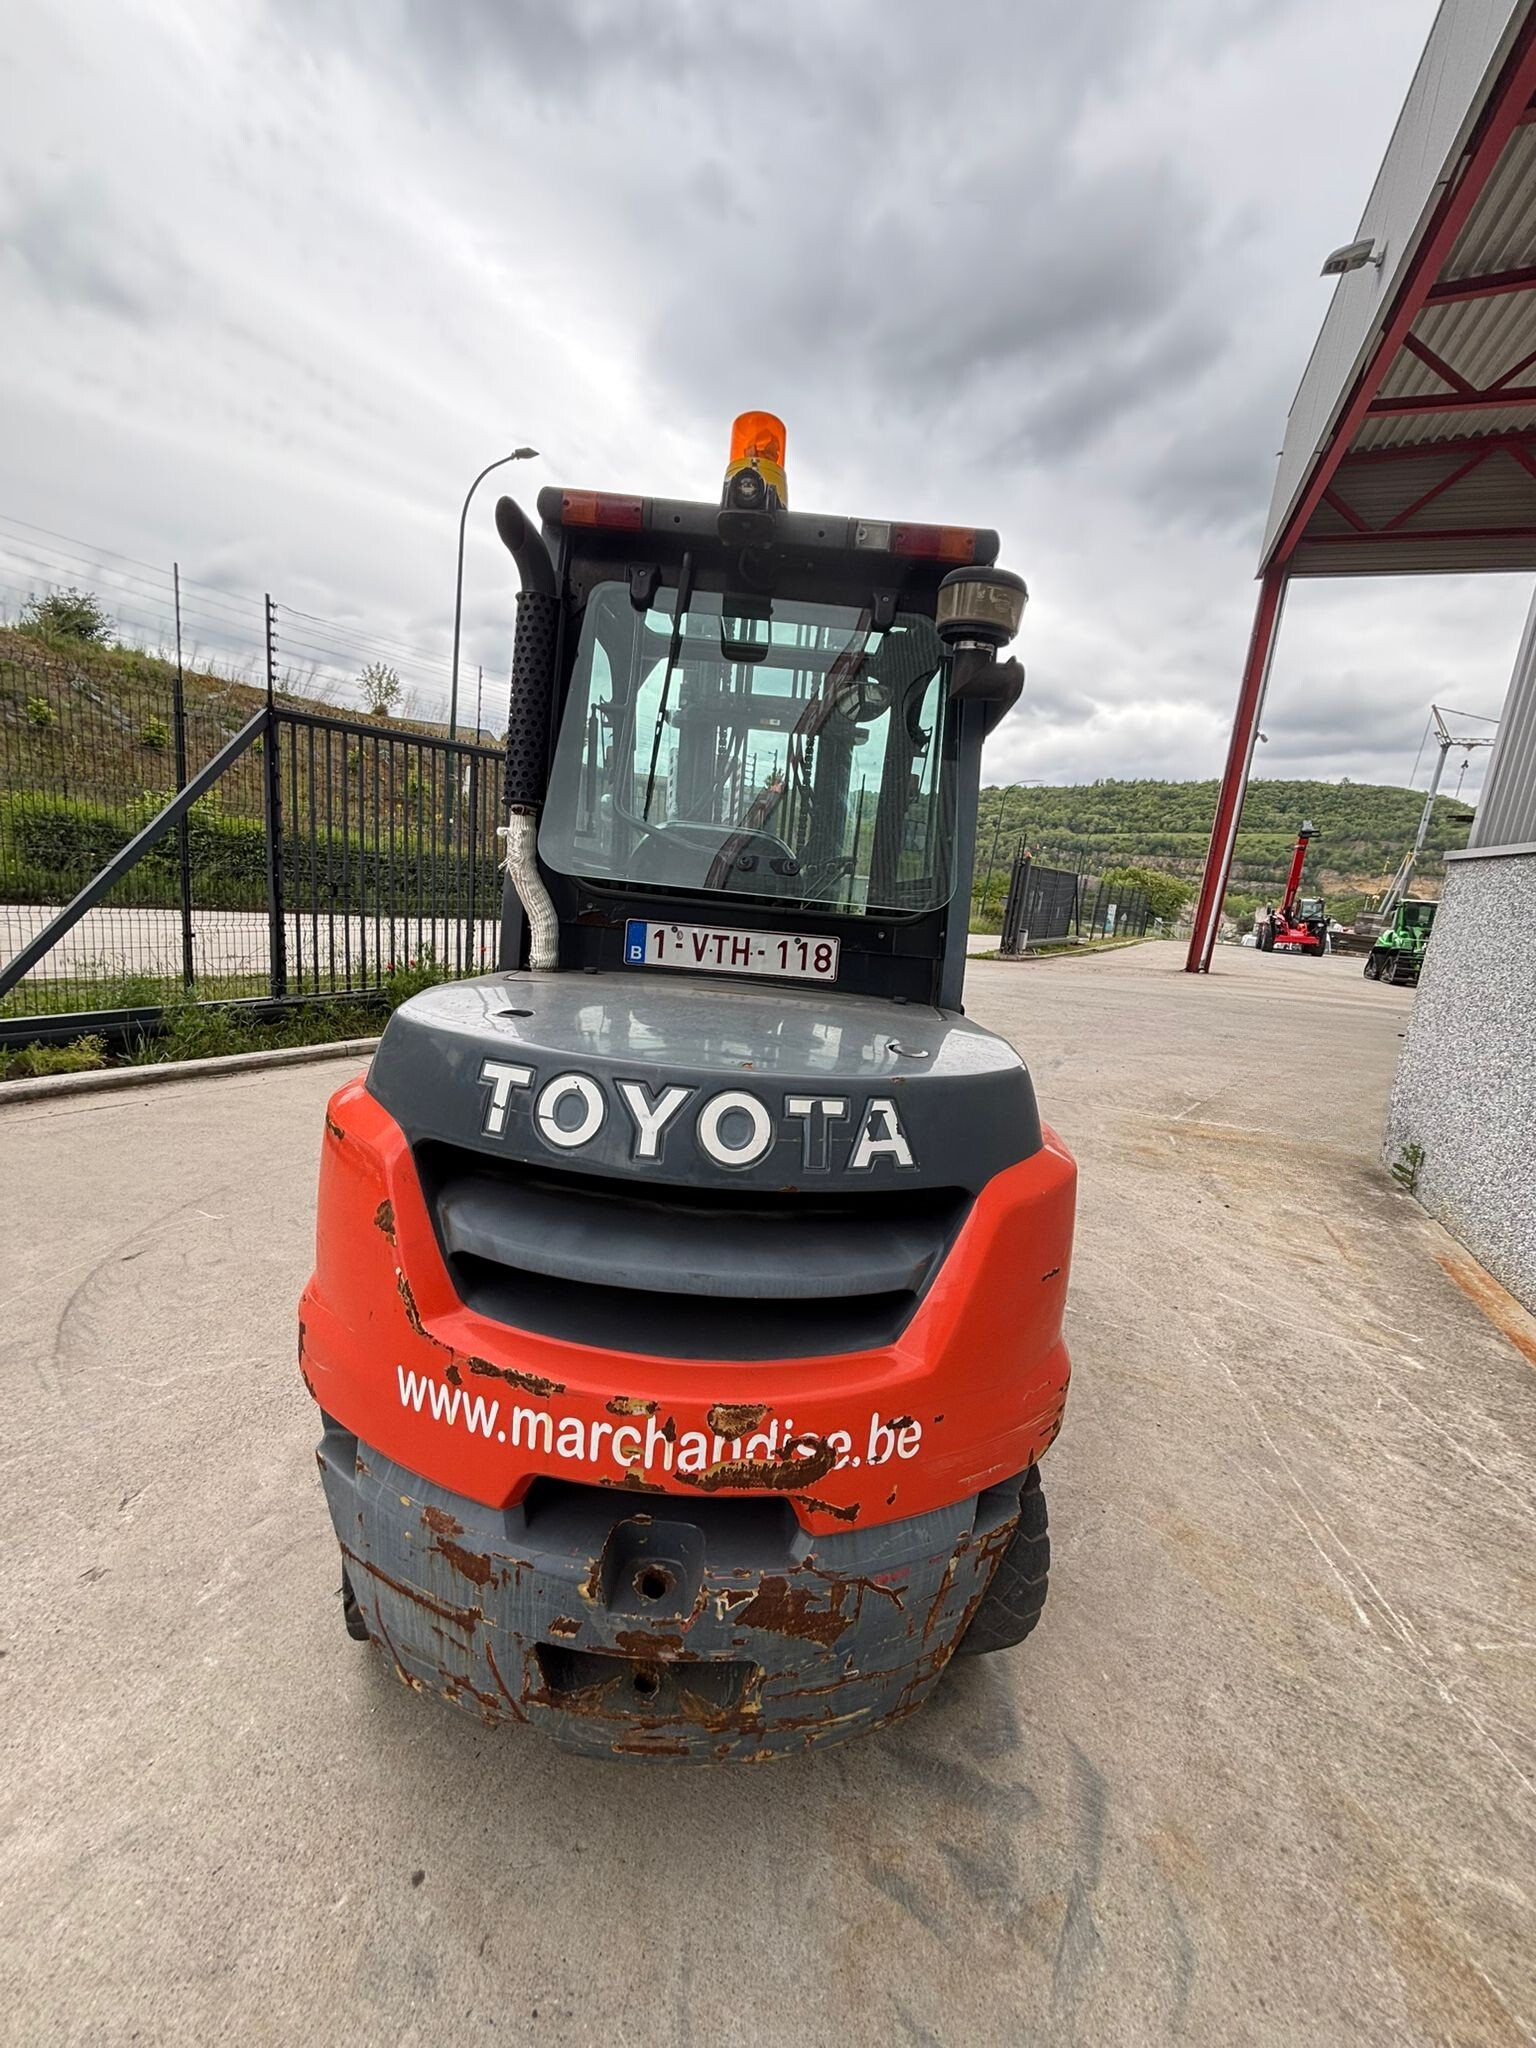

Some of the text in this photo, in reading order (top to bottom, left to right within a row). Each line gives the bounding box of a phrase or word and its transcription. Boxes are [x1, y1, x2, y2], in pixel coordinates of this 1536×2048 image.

[630, 945, 642, 960] B
[653, 929, 834, 973] 1-VTH-118
[480, 1060, 917, 1171] TOYOTA
